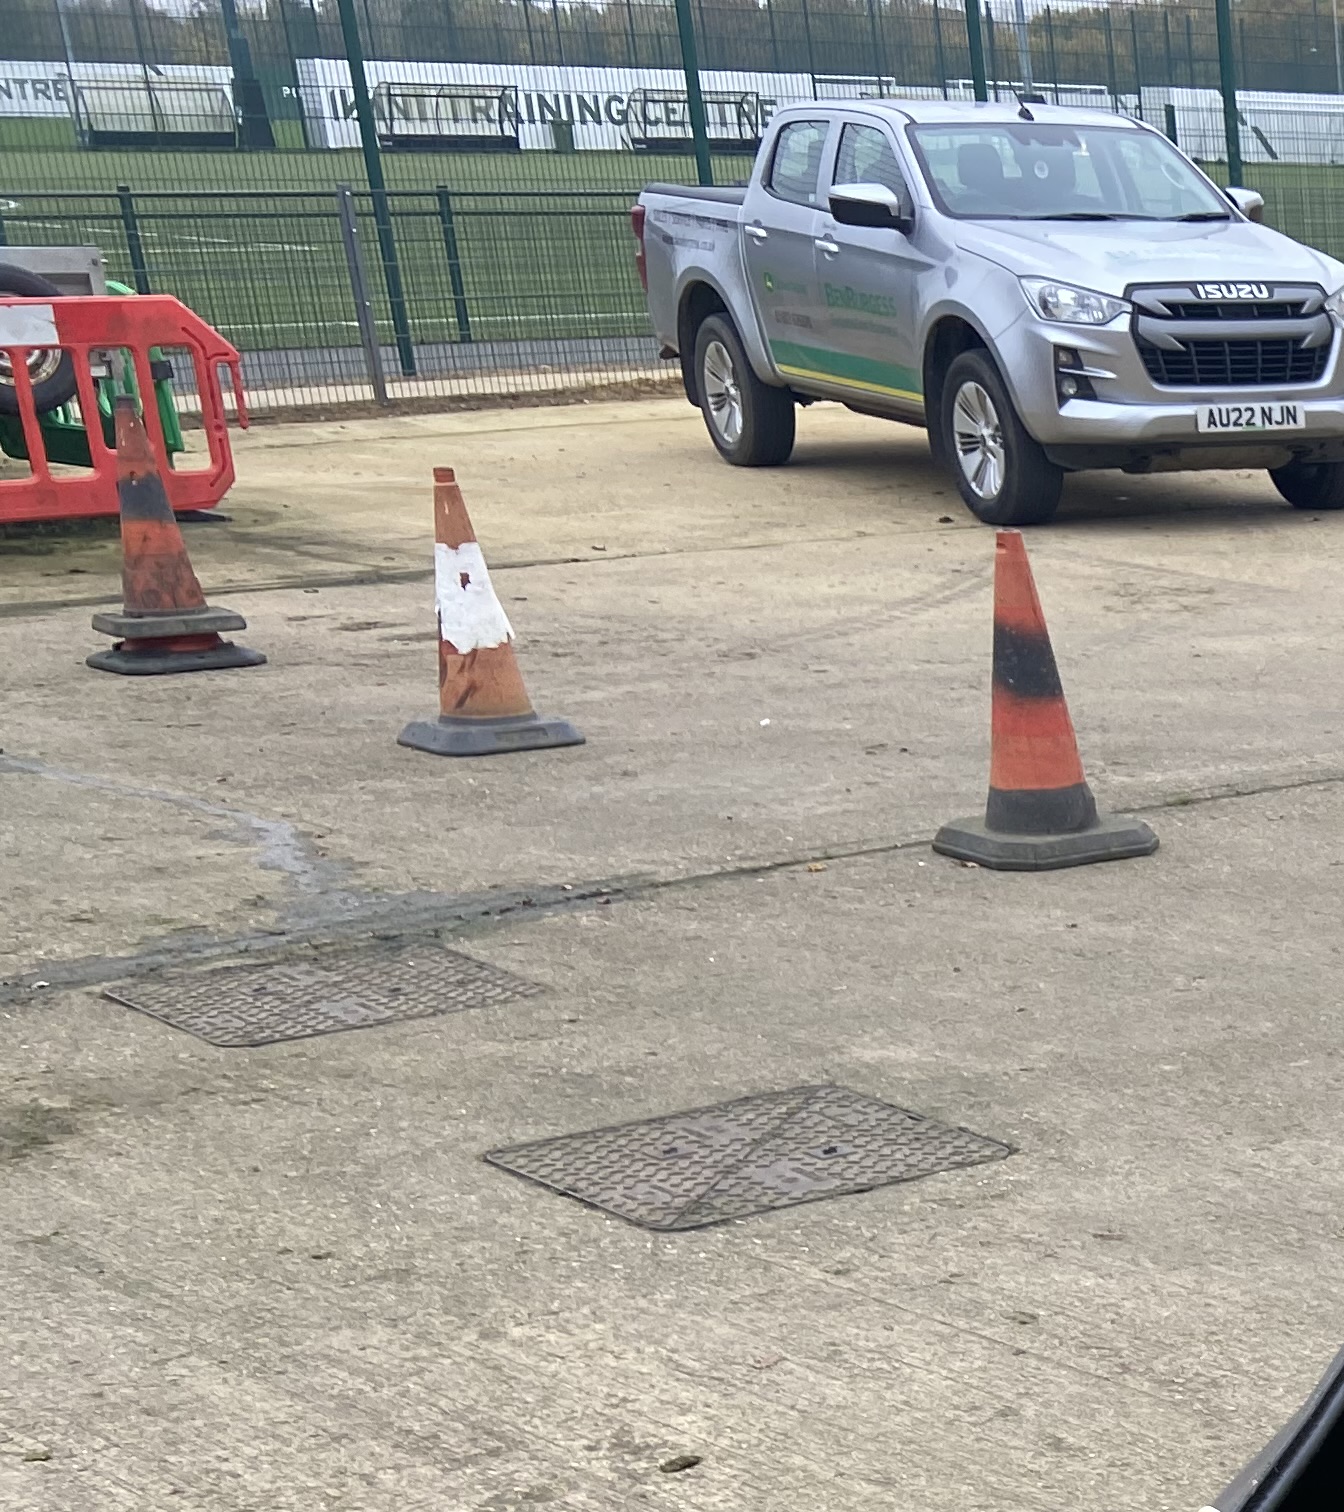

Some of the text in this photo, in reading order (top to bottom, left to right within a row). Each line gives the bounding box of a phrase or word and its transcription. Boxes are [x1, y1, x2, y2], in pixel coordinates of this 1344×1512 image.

[1197, 283, 1269, 299] ISUZU
[1207, 405, 1298, 429] AU22 NJN
